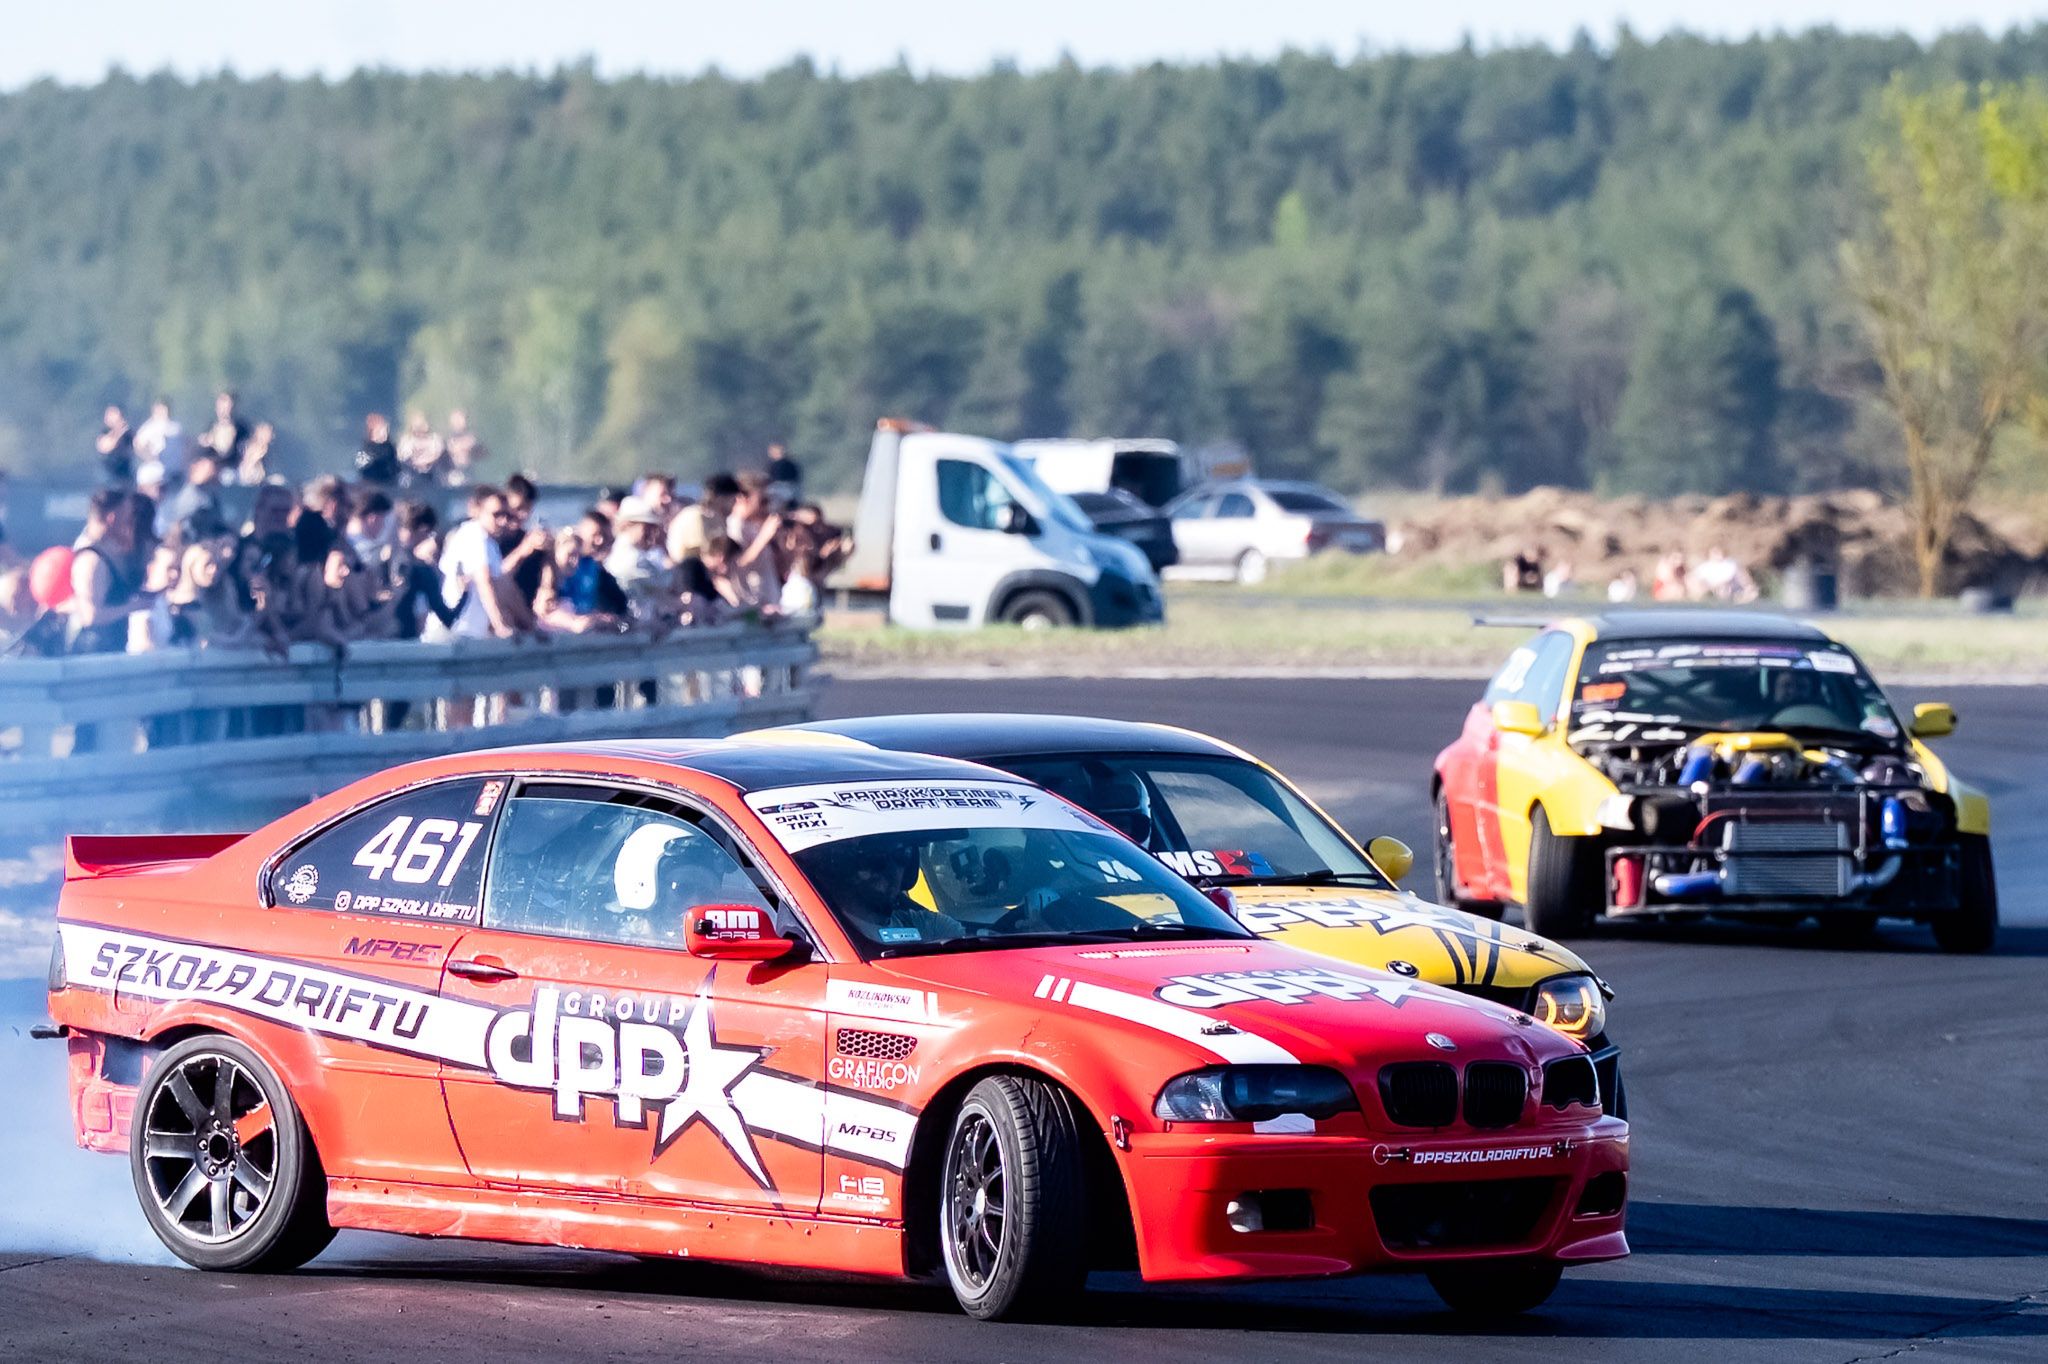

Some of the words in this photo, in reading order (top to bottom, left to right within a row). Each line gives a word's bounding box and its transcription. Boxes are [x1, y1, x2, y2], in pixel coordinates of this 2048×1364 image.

[938, 799, 1000, 809] TEAM
[787, 820, 828, 830] TAXI
[352, 816, 484, 887] 461
[353, 895, 381, 910] DPP
[428, 902, 476, 920] DRIFTU
[705, 910, 760, 929] AM
[705, 932, 760, 940] CARS
[90, 942, 257, 995] SZKOŁA
[252, 971, 429, 1040] DRIFTU
[564, 992, 688, 1025] GROUP
[828, 1058, 921, 1085] GRAFICON
[853, 1074, 896, 1090] STUDIO
[839, 1123, 897, 1143] MPBS
